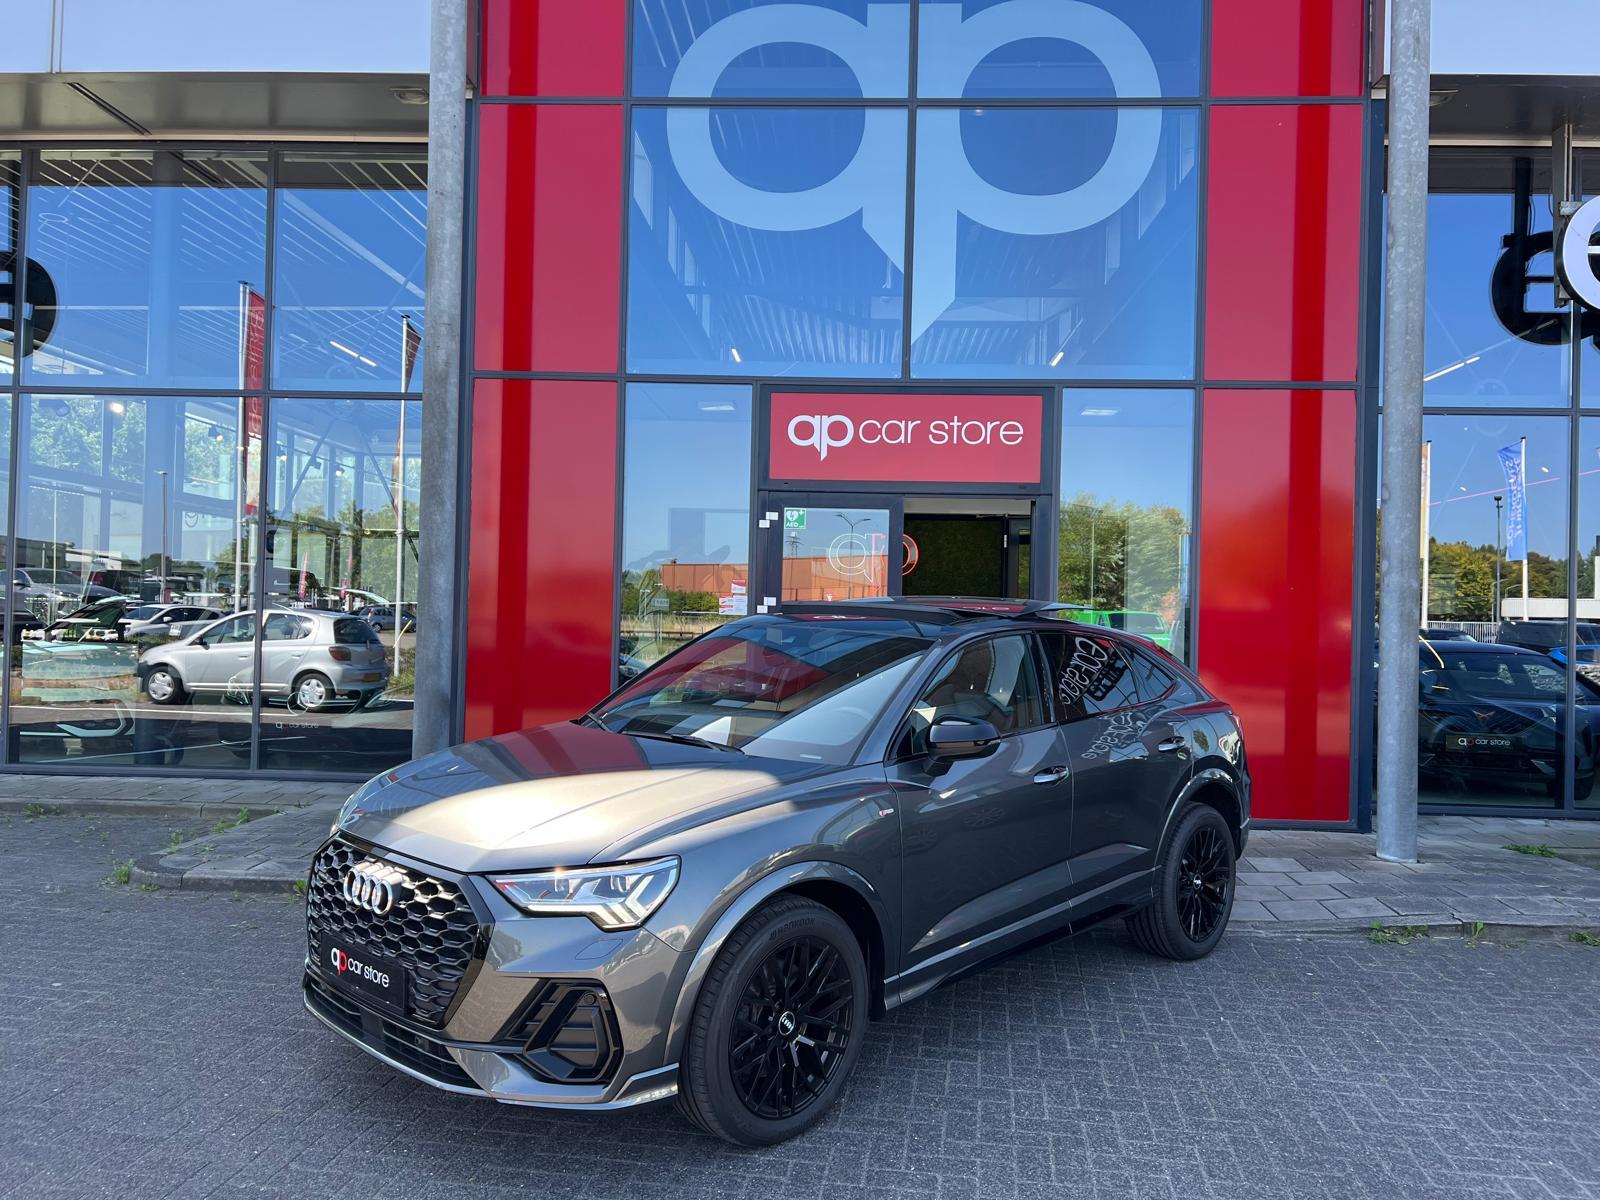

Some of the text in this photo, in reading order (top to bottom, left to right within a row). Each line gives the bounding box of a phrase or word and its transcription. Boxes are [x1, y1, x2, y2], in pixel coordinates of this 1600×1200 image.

[667, 0, 1163, 346] ap
[787, 414, 1024, 462] ap car store
[331, 947, 390, 988] ap car store
